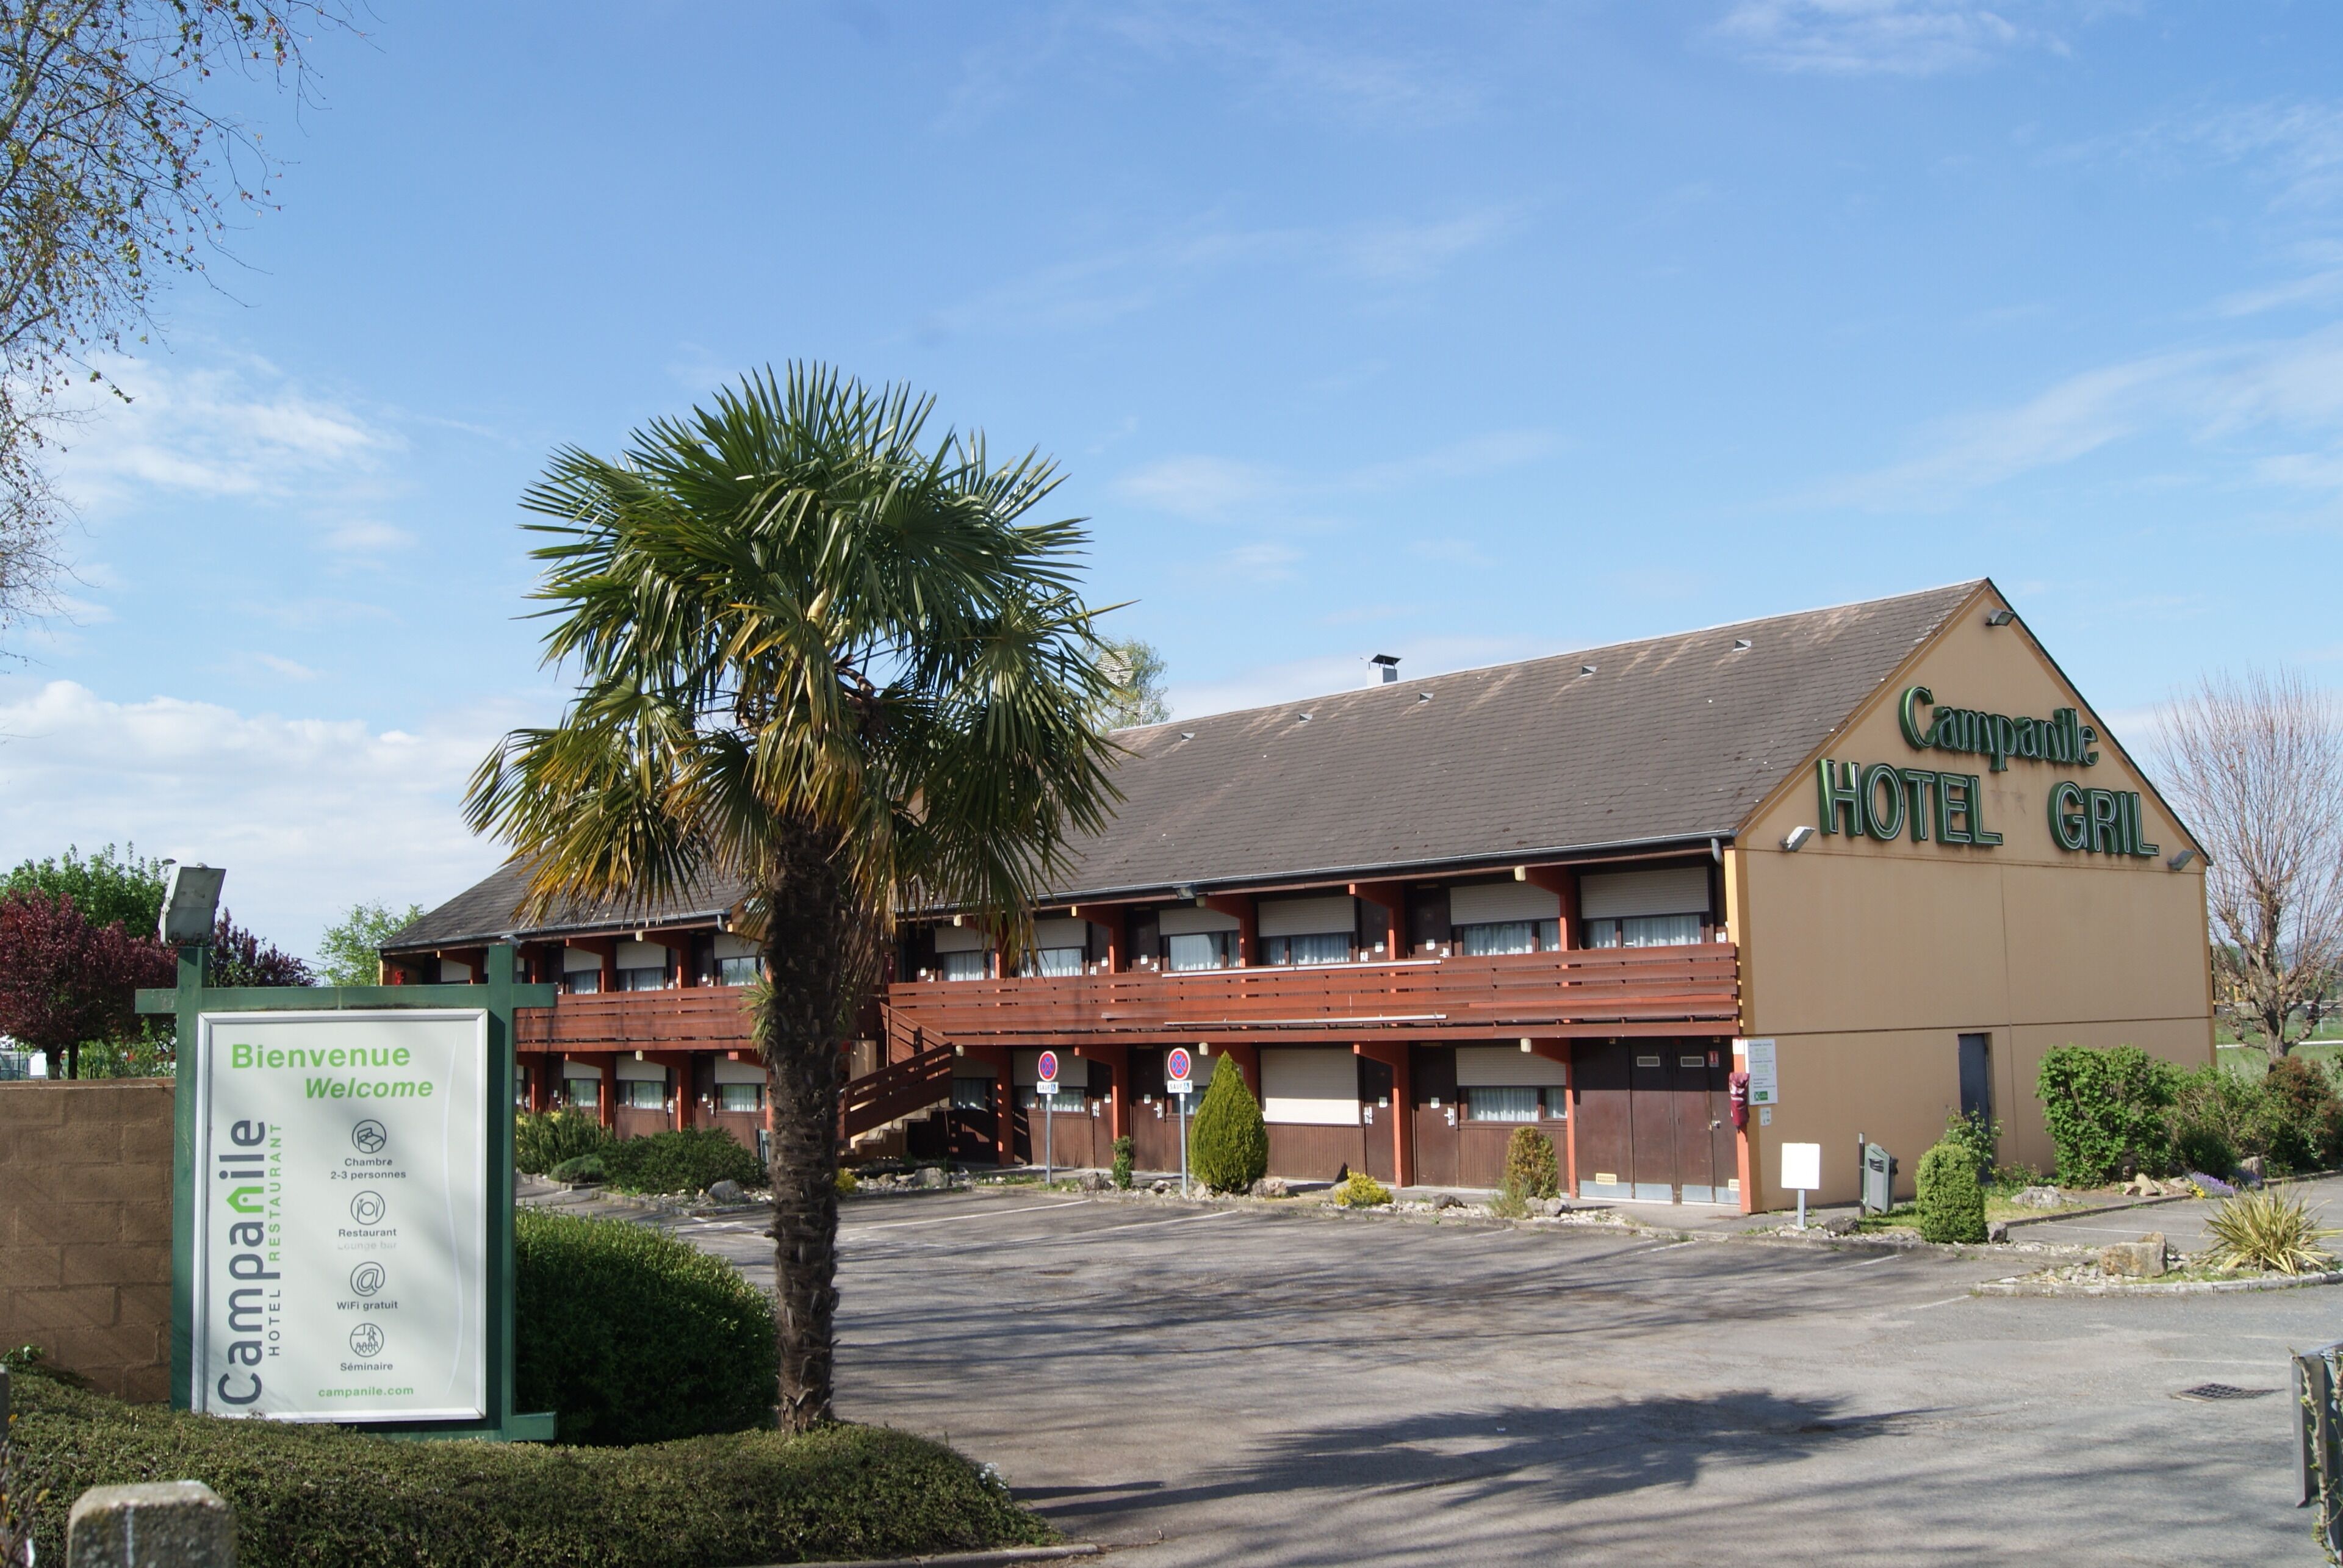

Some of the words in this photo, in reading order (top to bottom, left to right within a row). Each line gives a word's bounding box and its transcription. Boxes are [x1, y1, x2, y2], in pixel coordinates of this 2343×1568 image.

[1898, 686, 2099, 772] Campanile
[1817, 758, 2003, 846] HOTEL
[2048, 780, 2160, 857] GRIL
[232, 1043, 411, 1068] Bienvenue
[306, 1077, 434, 1099] Welcome
[344, 1157, 393, 1167] Chambre
[330, 1171, 348, 1180] 2-3
[350, 1171, 406, 1181] personnes
[268, 1124, 282, 1261] RESTAURANT
[338, 1228, 397, 1237] Restaurant
[380, 1240, 397, 1250] bar
[217, 1120, 281, 1405] Campanile
[336, 1301, 359, 1310] WiFi
[362, 1300, 398, 1312] gratuit
[268, 1289, 281, 1356] HOTEL
[340, 1362, 394, 1372] Séminaire
[318, 1386, 414, 1398] campanile.com
